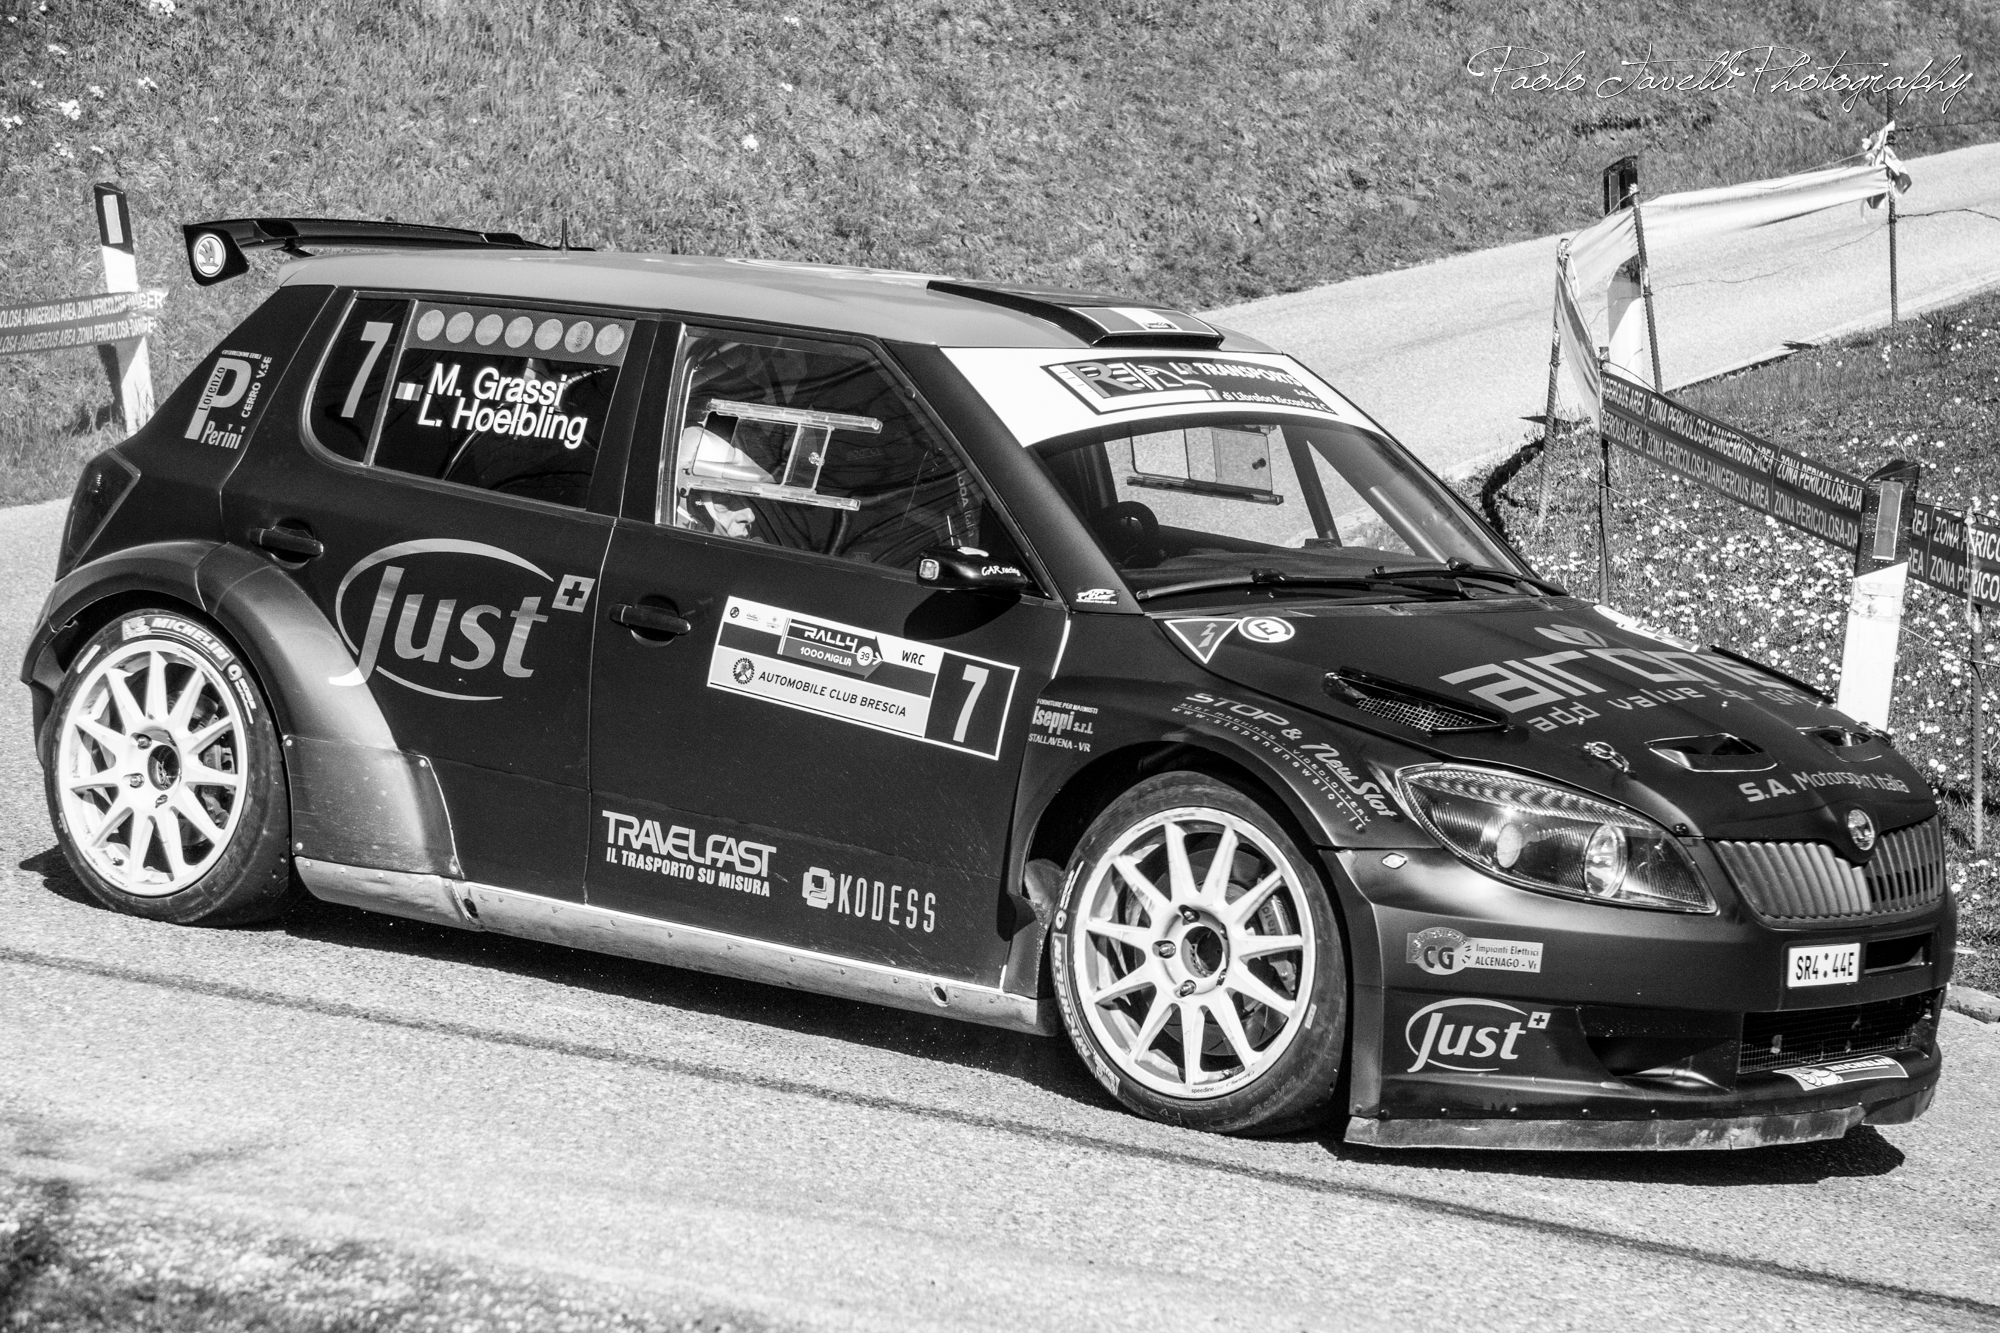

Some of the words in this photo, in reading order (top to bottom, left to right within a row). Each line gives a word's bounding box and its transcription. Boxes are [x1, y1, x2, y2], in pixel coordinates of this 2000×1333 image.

[61, 302, 76, 321] AREA
[58, 329, 76, 346] AREA
[341, 321, 393, 418] 7
[427, 362, 462, 396] M.
[474, 367, 567, 406] Grassi
[1168, 362, 1199, 375] LR
[1192, 362, 1302, 387] TRANSPORTS
[198, 367, 226, 411] Lorenzo
[241, 382, 261, 418] CERRO
[1222, 391, 1234, 401] di
[200, 420, 246, 450] Perini
[417, 394, 442, 427] L.
[452, 397, 588, 449] Hoelbling
[1629, 389, 1646, 418] AREA
[1650, 397, 1667, 426] ZONA
[1776, 455, 1799, 486] ZONA
[1626, 423, 1642, 452] AREA
[1646, 432, 1664, 461] ZONA
[1664, 440, 1749, 500] PERICOLOSA-DANGEROUS
[1750, 480, 1770, 511] AREA
[1774, 490, 1795, 522] ZONA
[1933, 516, 1959, 550] ZONA
[1930, 555, 1955, 589] ZONA
[152, 617, 231, 661] MICHELIN
[329, 565, 549, 686] Just
[803, 626, 858, 653] RALLY
[800, 646, 824, 660] 1000
[824, 650, 852, 667] MIGLIA
[860, 651, 871, 662] 39
[901, 650, 926, 666] WRC
[758, 671, 828, 697] AUTOMOBILE
[829, 689, 857, 705] CLUB
[860, 696, 907, 717] BRESCIA
[952, 663, 990, 743] 7
[1527, 702, 1601, 732] add
[1607, 687, 1706, 710] value
[1032, 706, 1075, 735] Iseppi
[1028, 733, 1073, 750] STALLAVENA
[1078, 742, 1091, 753] VR
[1186, 693, 1290, 726] STOP
[1281, 728, 1303, 740] &
[1338, 776, 1397, 817] Slot
[1293, 749, 1371, 823] VIDEOLOTTERY
[1738, 778, 1797, 802] S.A.
[602, 809, 777, 878] TRAVELFAST
[606, 847, 618, 864] IL
[621, 849, 695, 881] TRASPORTO
[697, 868, 716, 886] SU
[718, 872, 770, 898] MISURA
[837, 873, 936, 933] KODESS
[1423, 945, 1455, 970] CG
[1475, 956, 1519, 968] ALCENAGO
[1476, 943, 1508, 955] Impianti
[1407, 1012, 1527, 1073] Just
